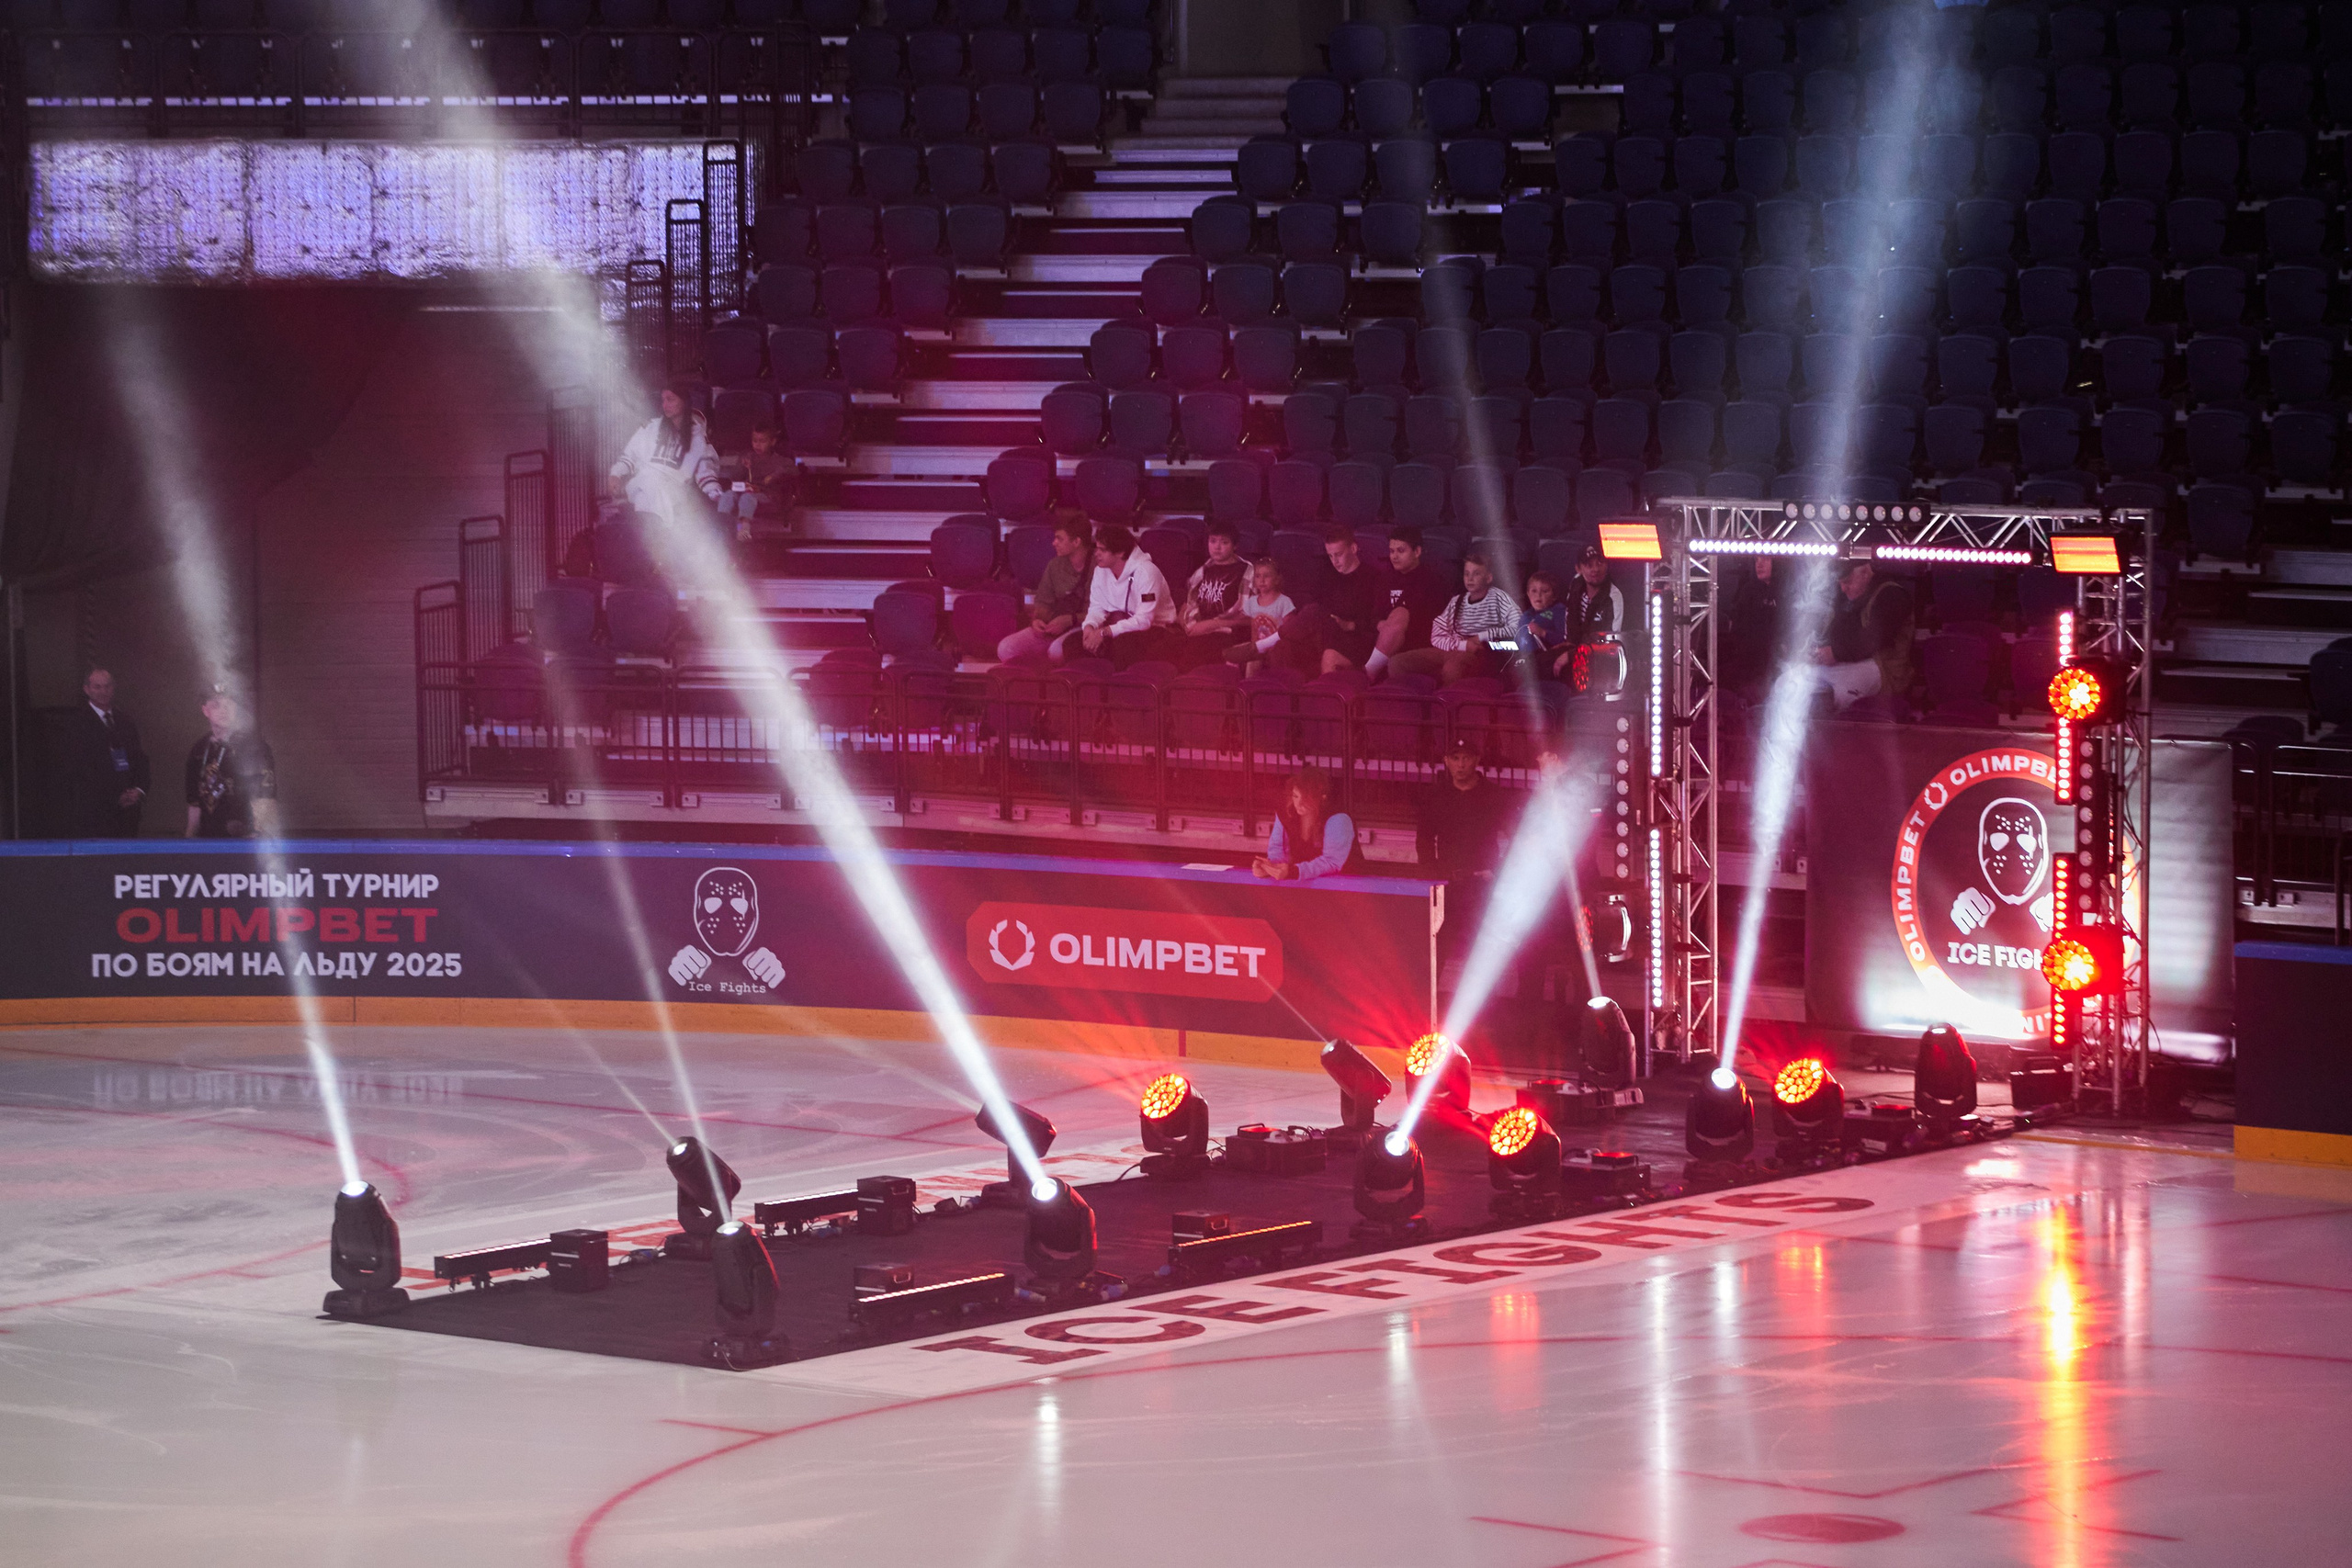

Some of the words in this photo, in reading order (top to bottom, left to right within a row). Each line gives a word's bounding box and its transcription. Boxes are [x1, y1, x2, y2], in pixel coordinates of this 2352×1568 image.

[1950, 754, 2057, 786] OLIMPBE
[114, 868, 315, 898] РЕГУЛЯРНЫЙ
[322, 874, 440, 898] ТУРНИР
[1898, 810, 1927, 962] OLIMPBET
[115, 907, 439, 943] OLIMPBET
[92, 953, 138, 977] ПО
[146, 952, 234, 976] БОЯМ
[243, 953, 286, 976] НА
[293, 953, 378, 979] ЛЬДУ
[387, 952, 463, 977] 2025
[1049, 932, 1267, 978] OLIMPBET
[1947, 942, 1992, 966] ICE
[1994, 944, 2043, 971] FIG
[688, 981, 712, 992] Ice
[719, 982, 767, 996] Fights
[911, 1294, 1330, 1366] ICE
[1255, 1191, 1875, 1301] FIGHTS
